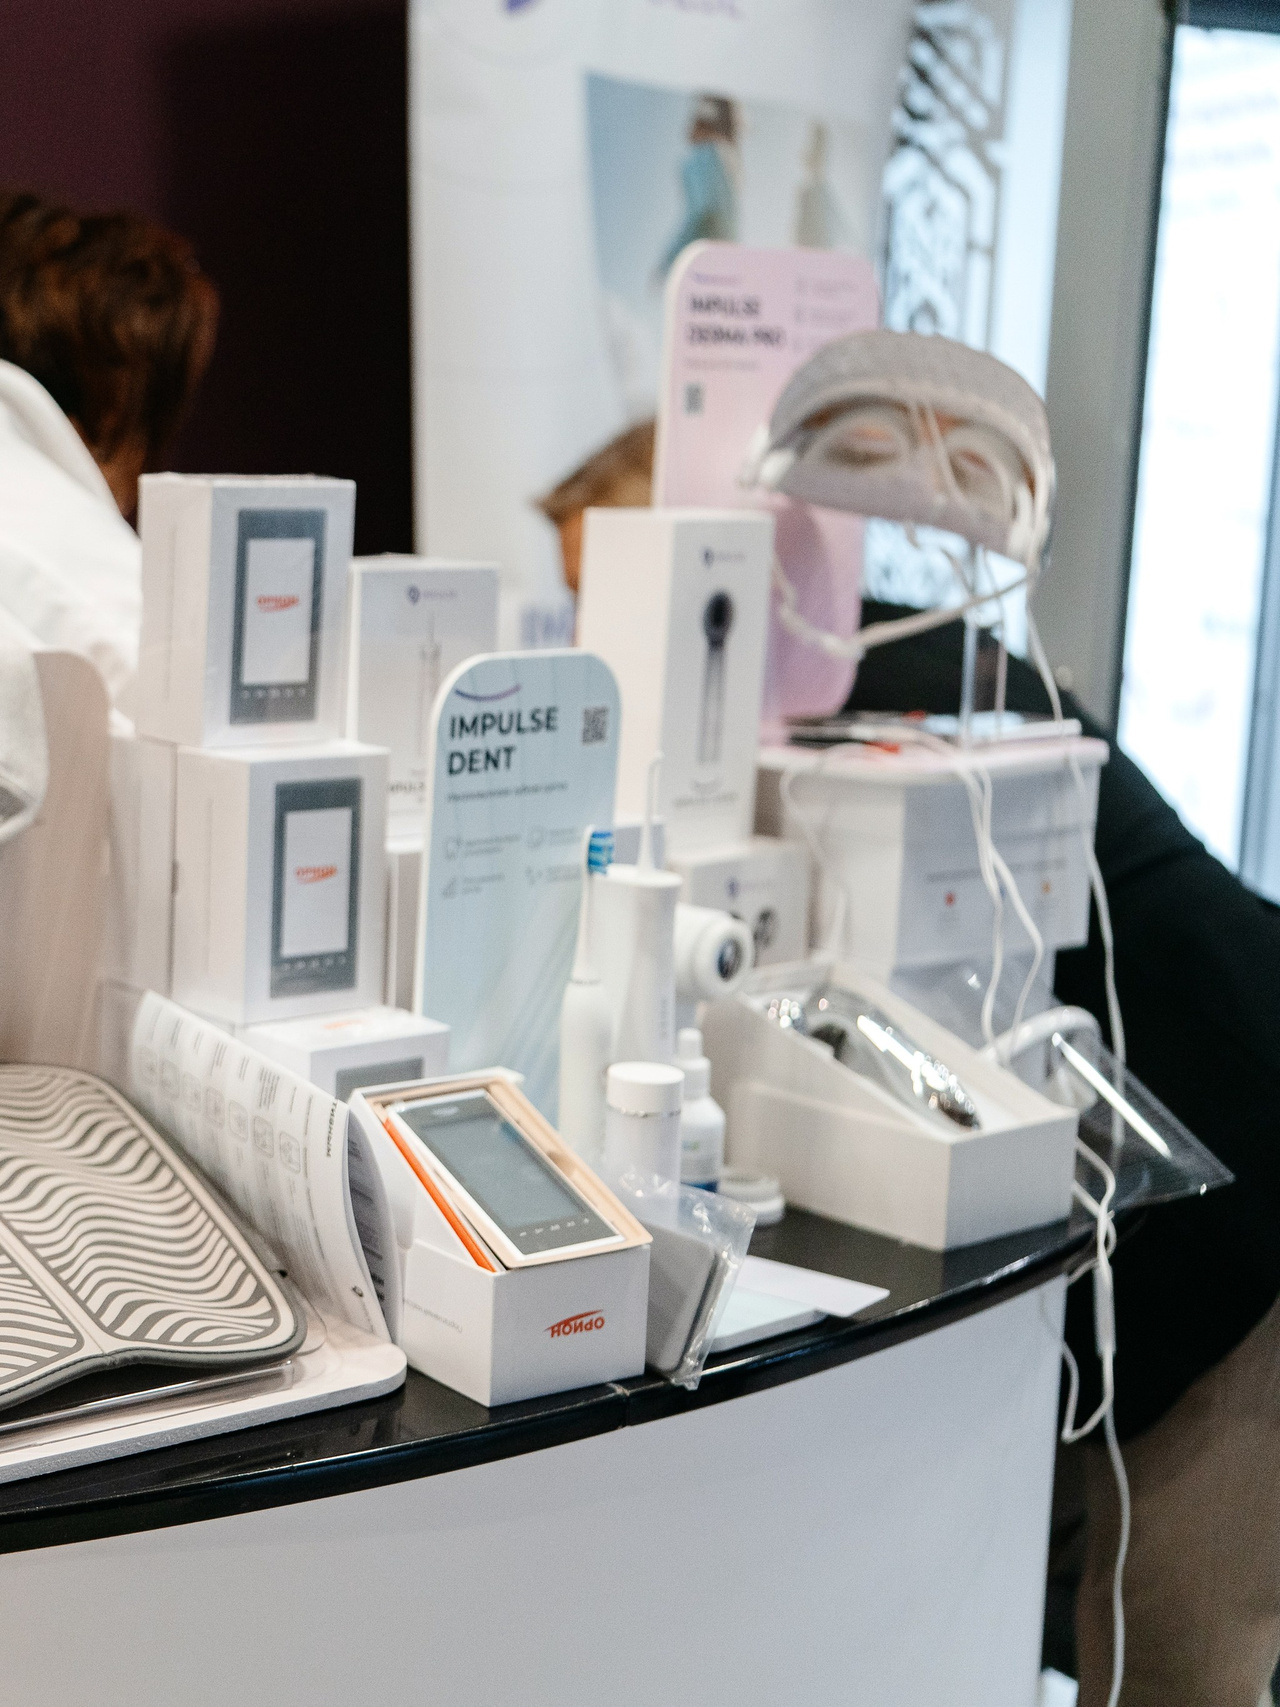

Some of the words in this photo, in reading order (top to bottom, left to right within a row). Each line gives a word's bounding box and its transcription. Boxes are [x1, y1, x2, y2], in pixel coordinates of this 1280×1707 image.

[449, 705, 559, 741] IMPULSE
[447, 746, 516, 777] DENT
[550, 1315, 606, 1339] ОРИОН
